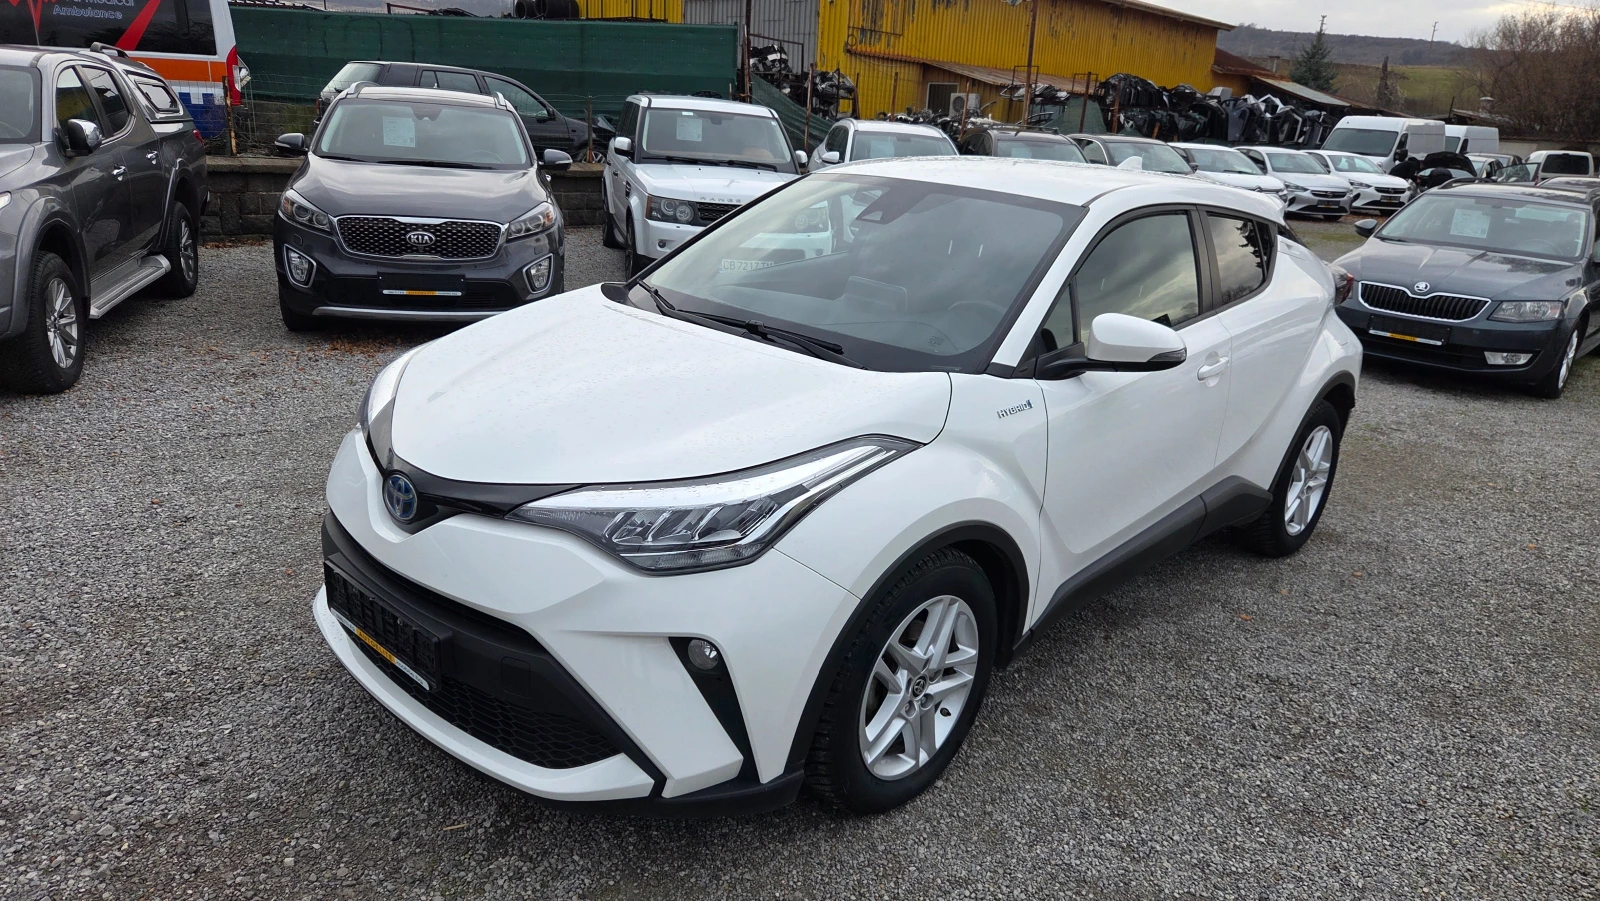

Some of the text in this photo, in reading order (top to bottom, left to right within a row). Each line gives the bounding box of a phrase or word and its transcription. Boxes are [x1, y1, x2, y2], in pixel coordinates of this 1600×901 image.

[53, 5, 123, 19] Ambulance
[410, 234, 431, 244] KIA
[723, 260, 736, 270] CB
[737, 261, 760, 271] 7217
[997, 402, 1030, 419] HYBRID
[358, 630, 395, 662] AUTOELITE
